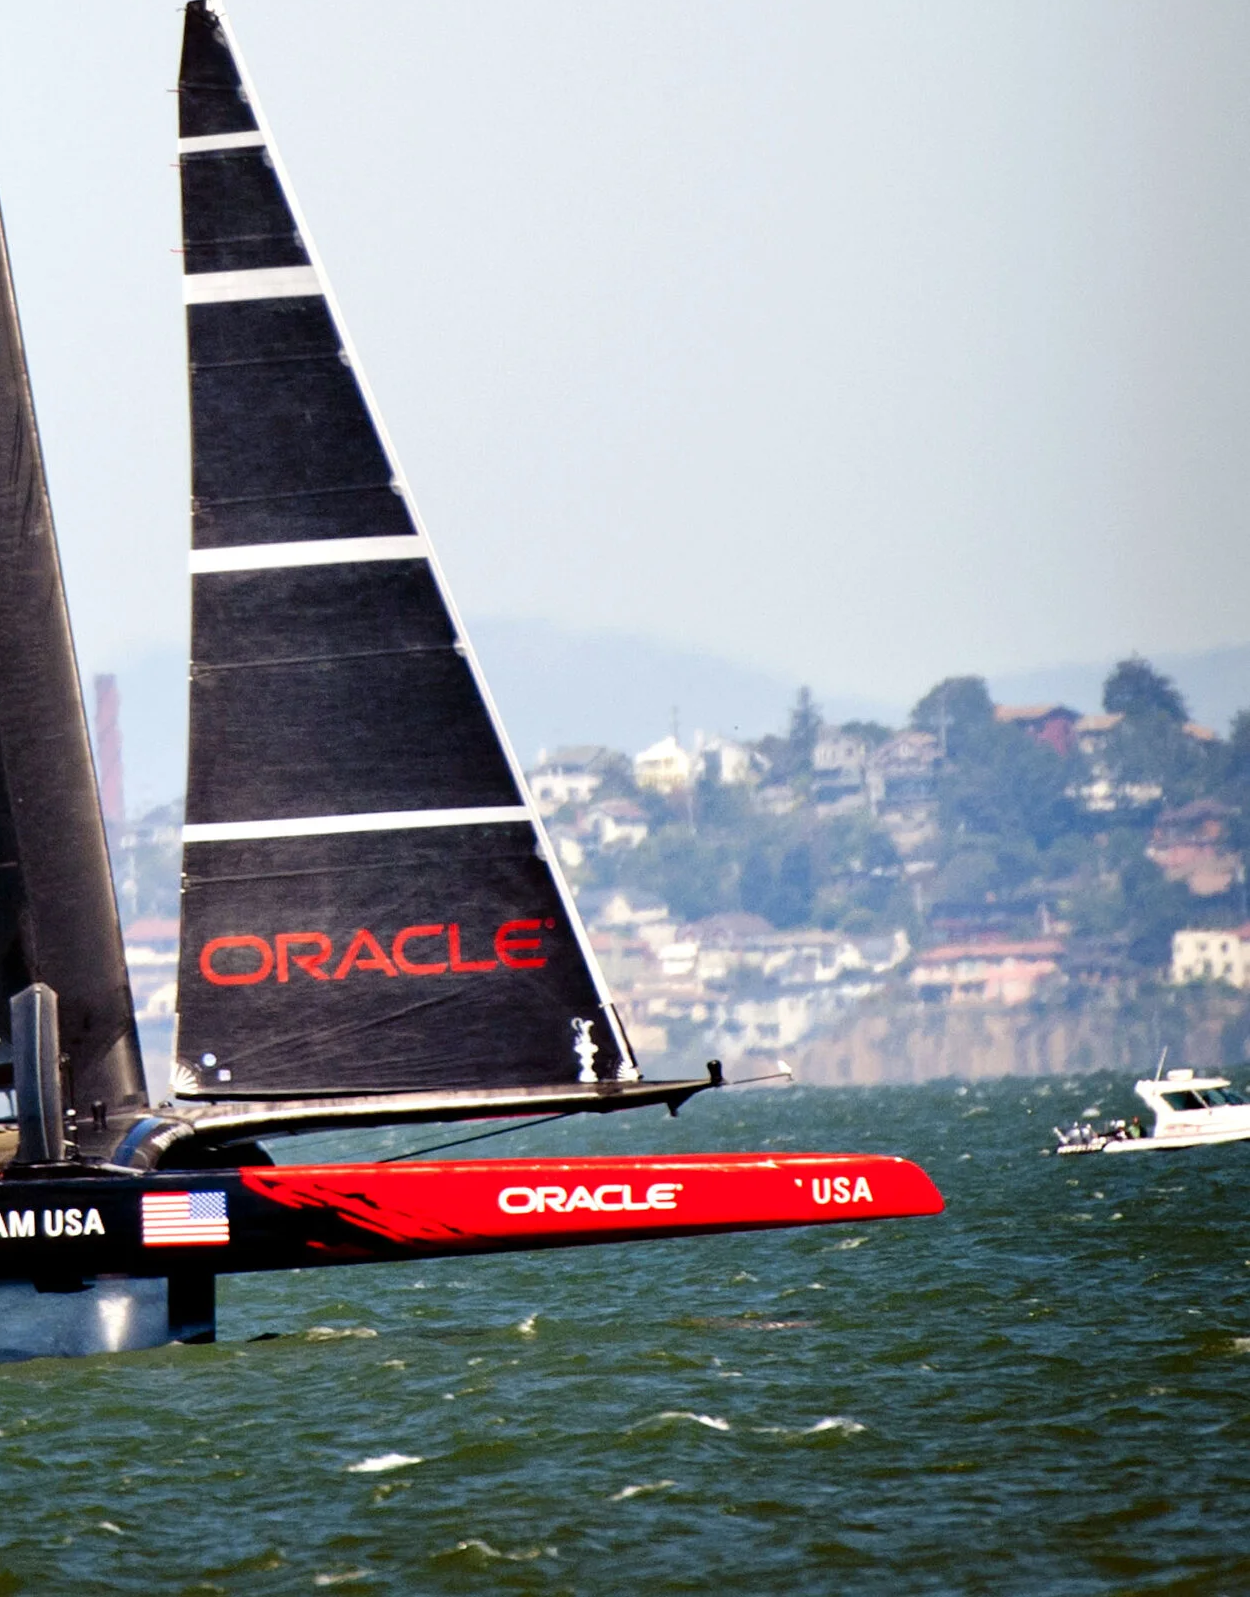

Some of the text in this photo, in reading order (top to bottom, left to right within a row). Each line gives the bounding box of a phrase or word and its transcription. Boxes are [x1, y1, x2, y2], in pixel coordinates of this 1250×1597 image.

[199, 918, 548, 986] ORACLE
[498, 1183, 677, 1214] ORACLE
[811, 1176, 874, 1205] USA
[44, 1208, 106, 1237] USA
